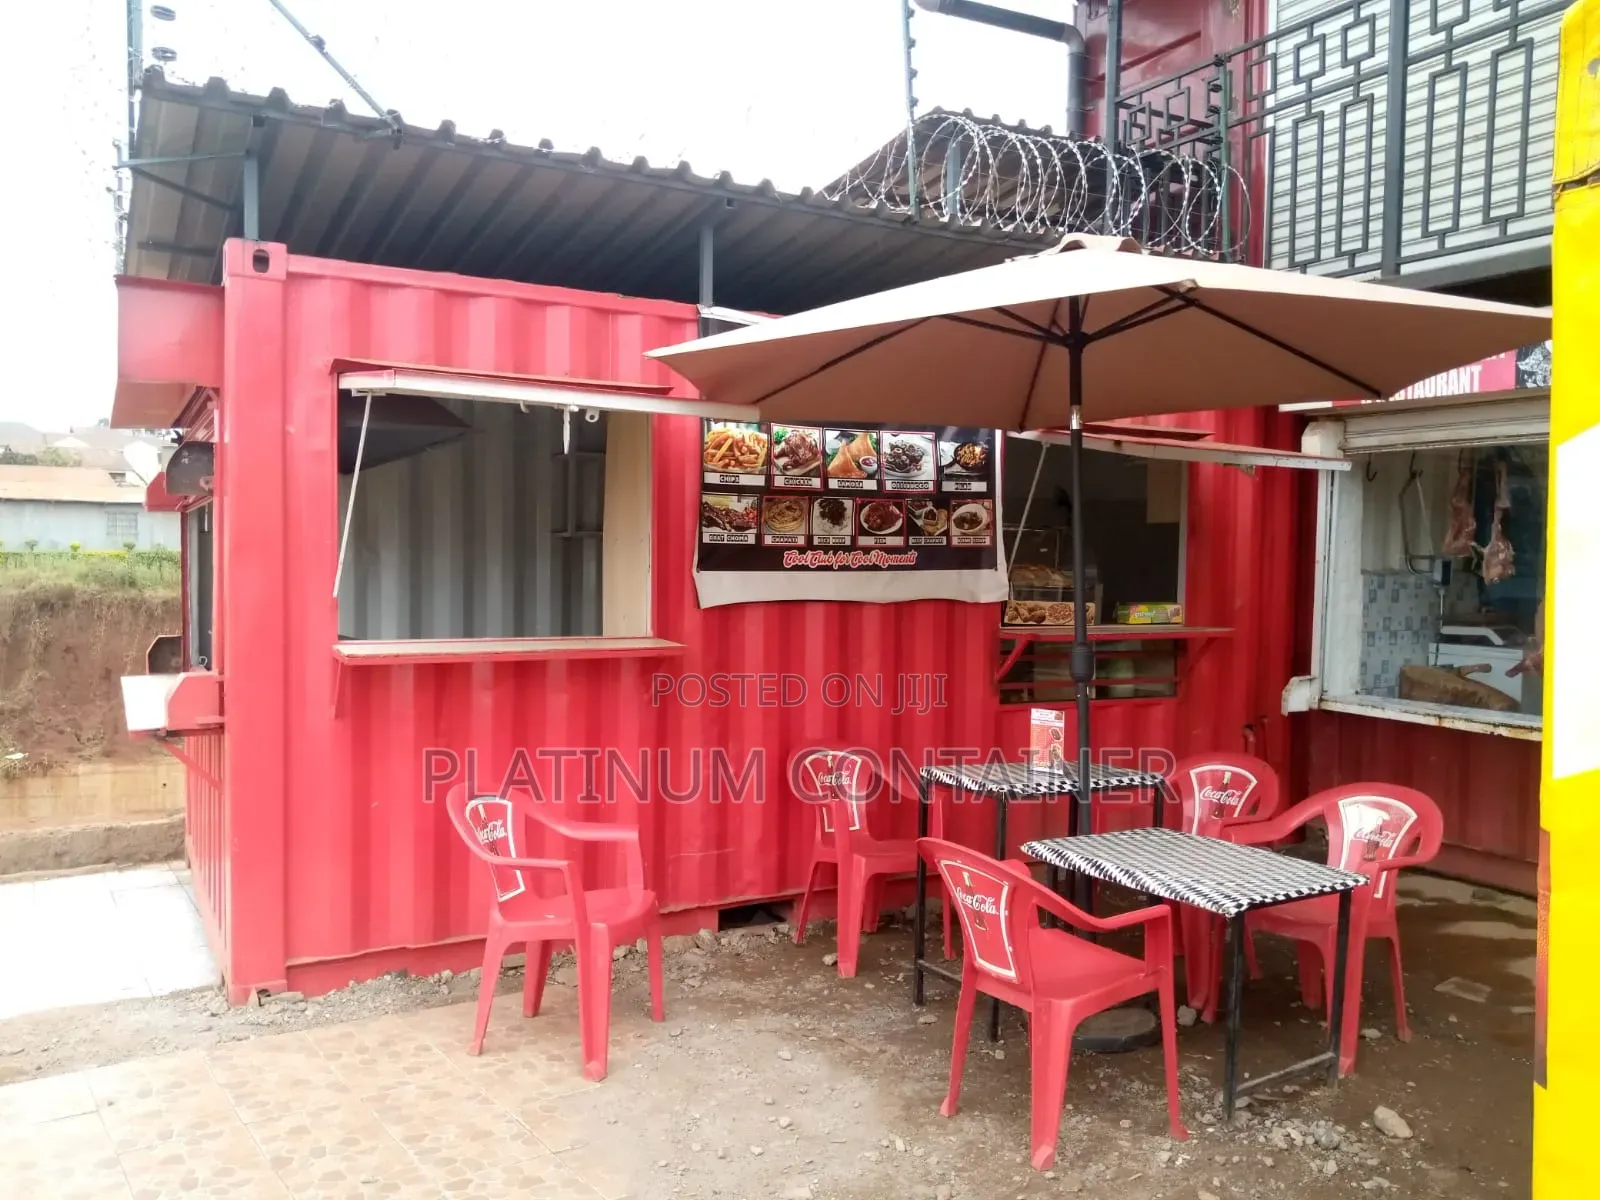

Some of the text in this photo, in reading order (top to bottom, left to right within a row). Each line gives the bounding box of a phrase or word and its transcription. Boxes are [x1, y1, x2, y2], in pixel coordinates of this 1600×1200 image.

[784, 477, 812, 486] CHICKEN
[783, 549, 917, 570] Cool Club for Cool Moments
